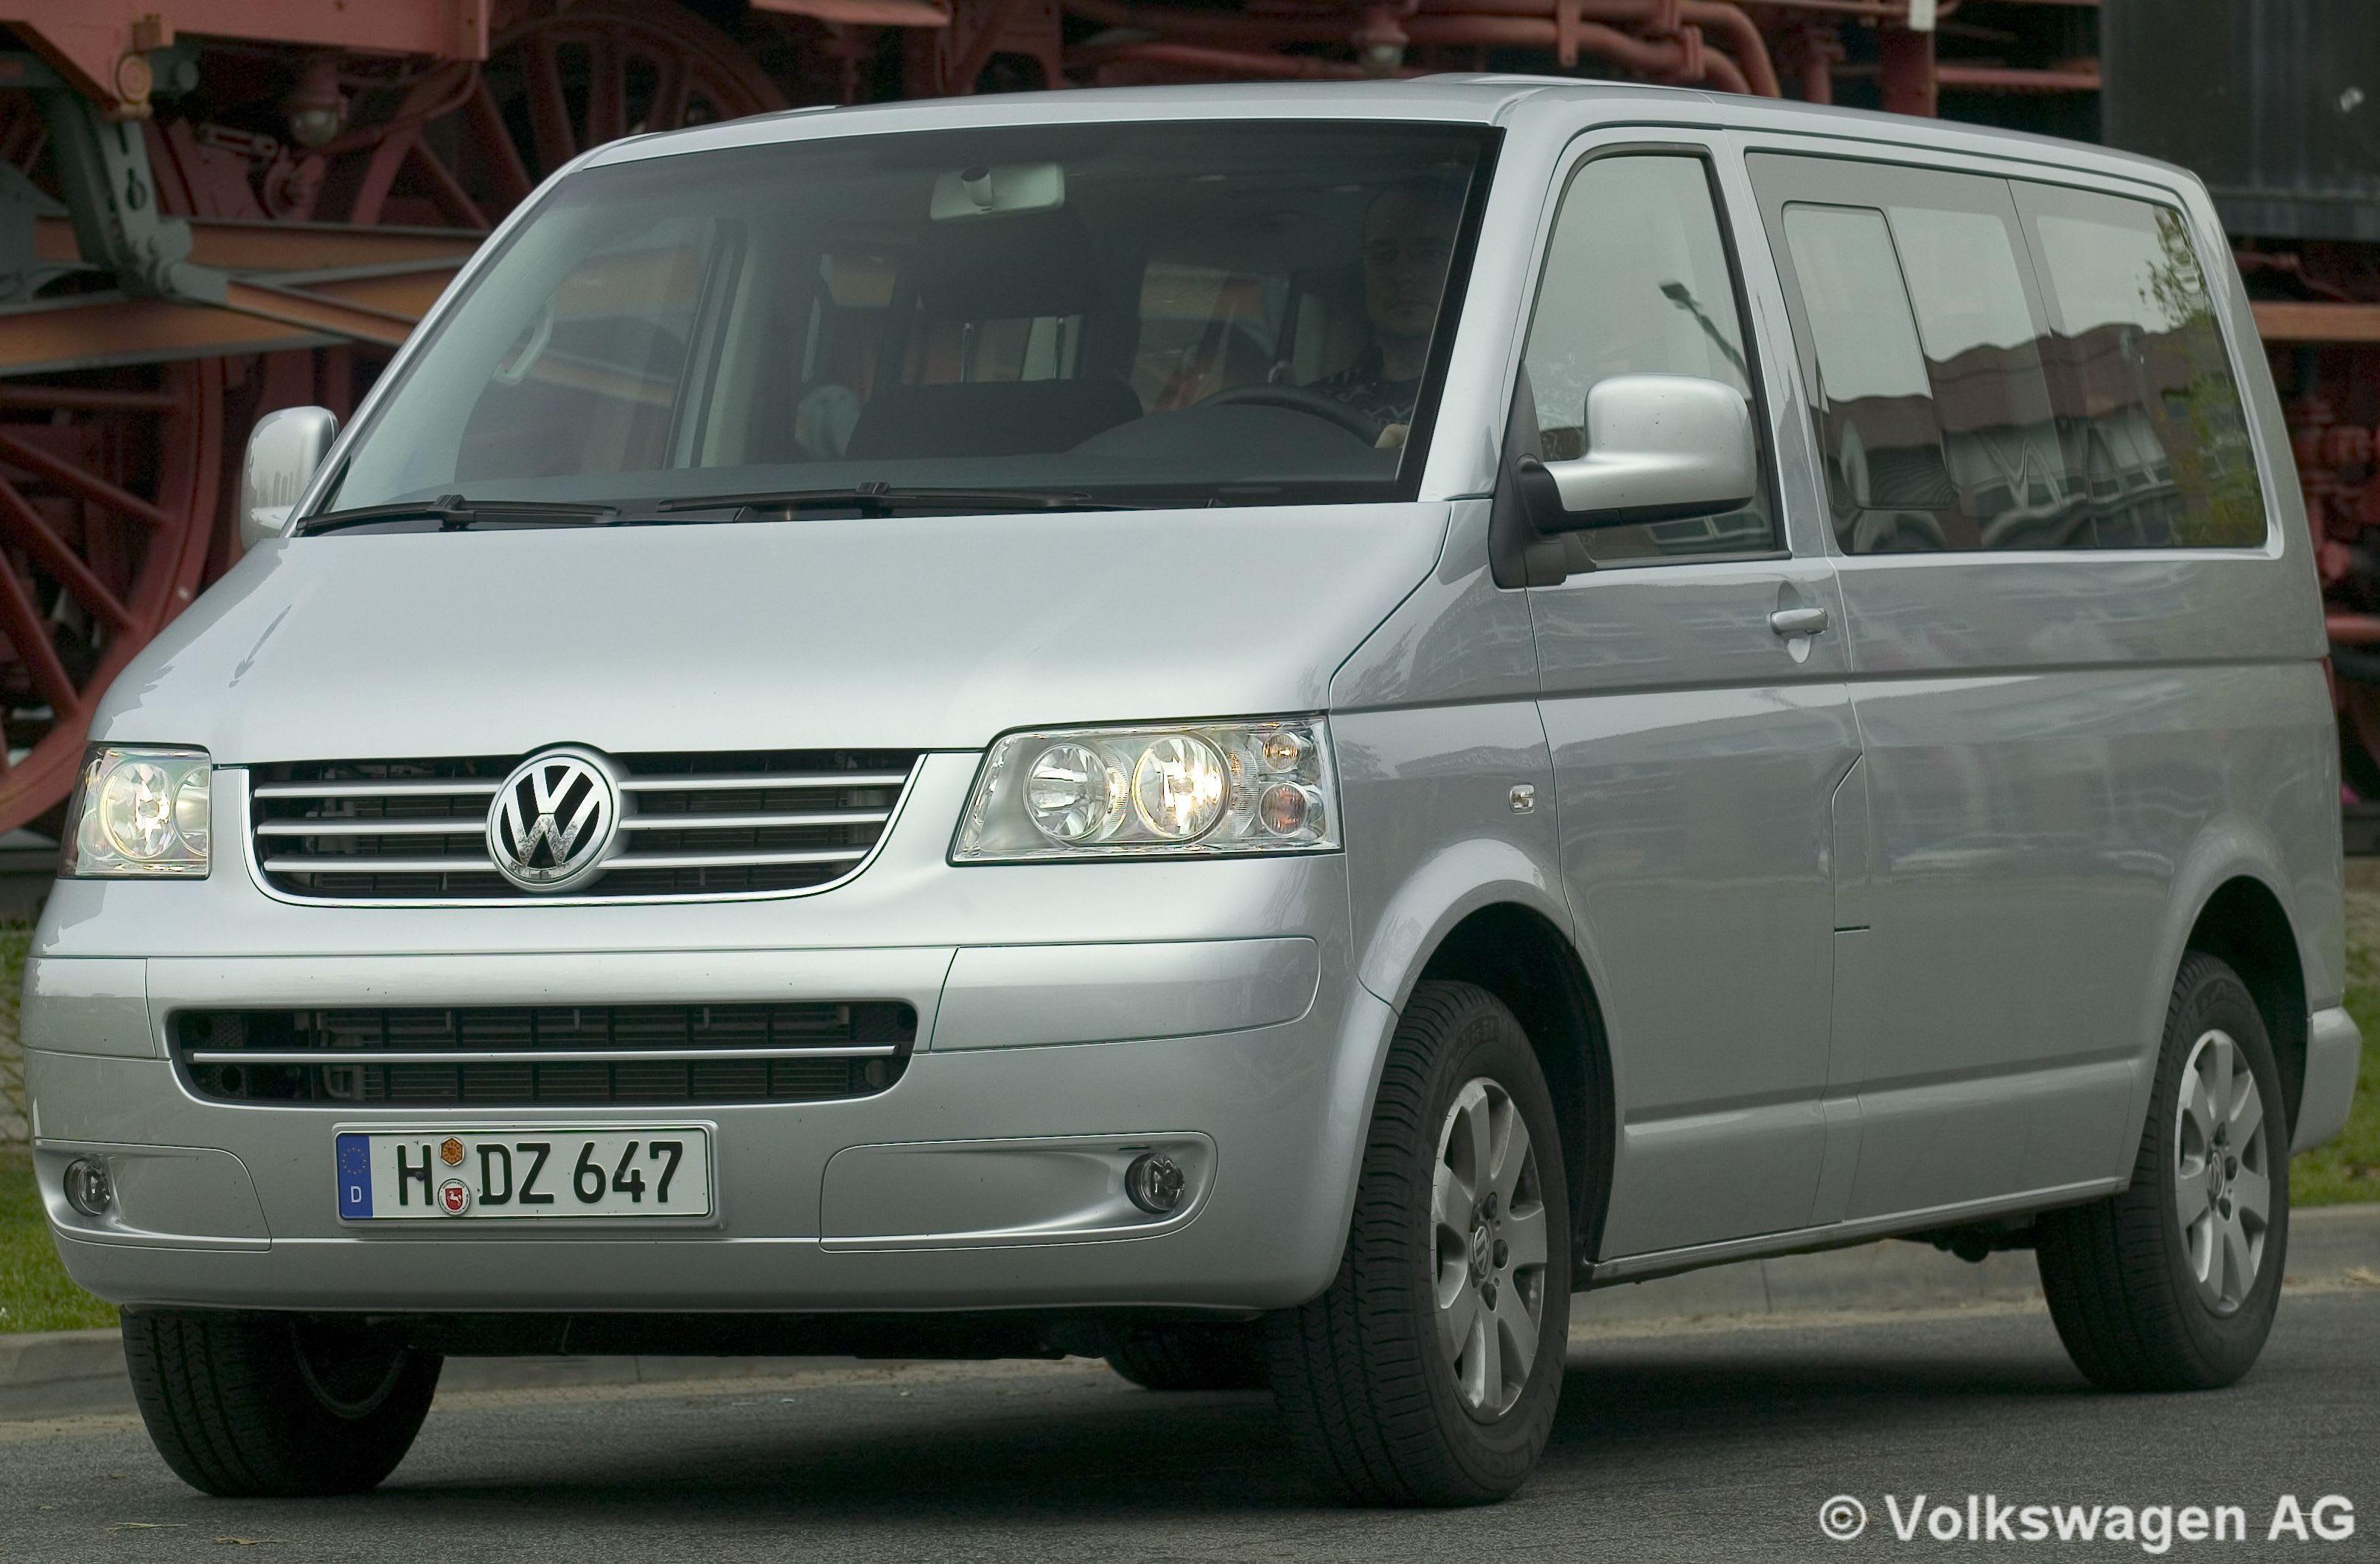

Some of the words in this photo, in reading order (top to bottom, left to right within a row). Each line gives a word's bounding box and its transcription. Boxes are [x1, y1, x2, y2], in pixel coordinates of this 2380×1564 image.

[493, 752, 612, 881] VW
[350, 1185, 362, 1203] D
[397, 1144, 433, 1205] H
[476, 1142, 555, 1205] DZ
[573, 1140, 684, 1204] 647
